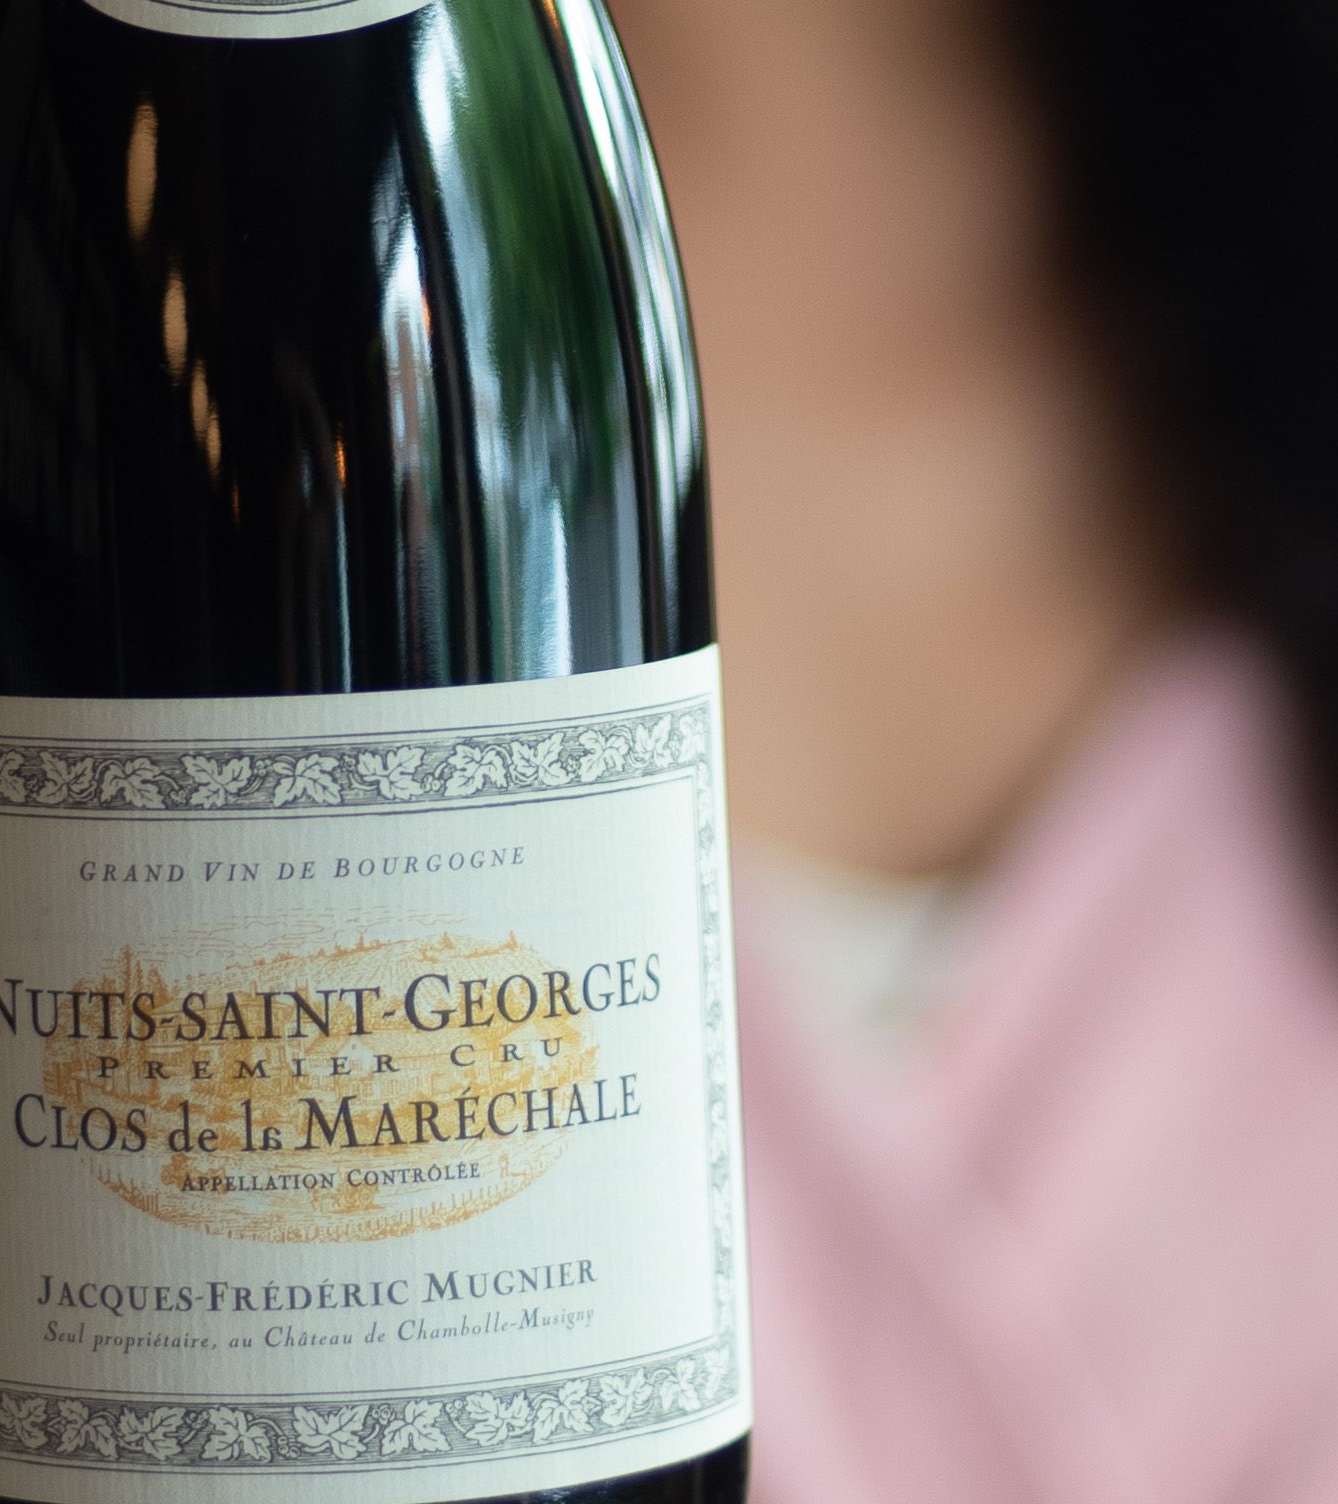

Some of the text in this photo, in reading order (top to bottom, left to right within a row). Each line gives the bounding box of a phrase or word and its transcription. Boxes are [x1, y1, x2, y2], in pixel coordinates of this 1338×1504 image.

[79, 845, 526, 883] GRAND VIN DE BOURGOGNE
[97, 1037, 563, 1080] PREMIER CRU
[13, 1072, 643, 1153] CLOS de la MARÉCHALE
[181, 1161, 482, 1193] APPELLATION CONTRÔLÉE
[37, 1258, 598, 1317] JACQUES-FRÉDÉRIC MUGNIER
[43, 1306, 595, 1353] Seul propriétaire, au Château de Chambolle-Musigny
